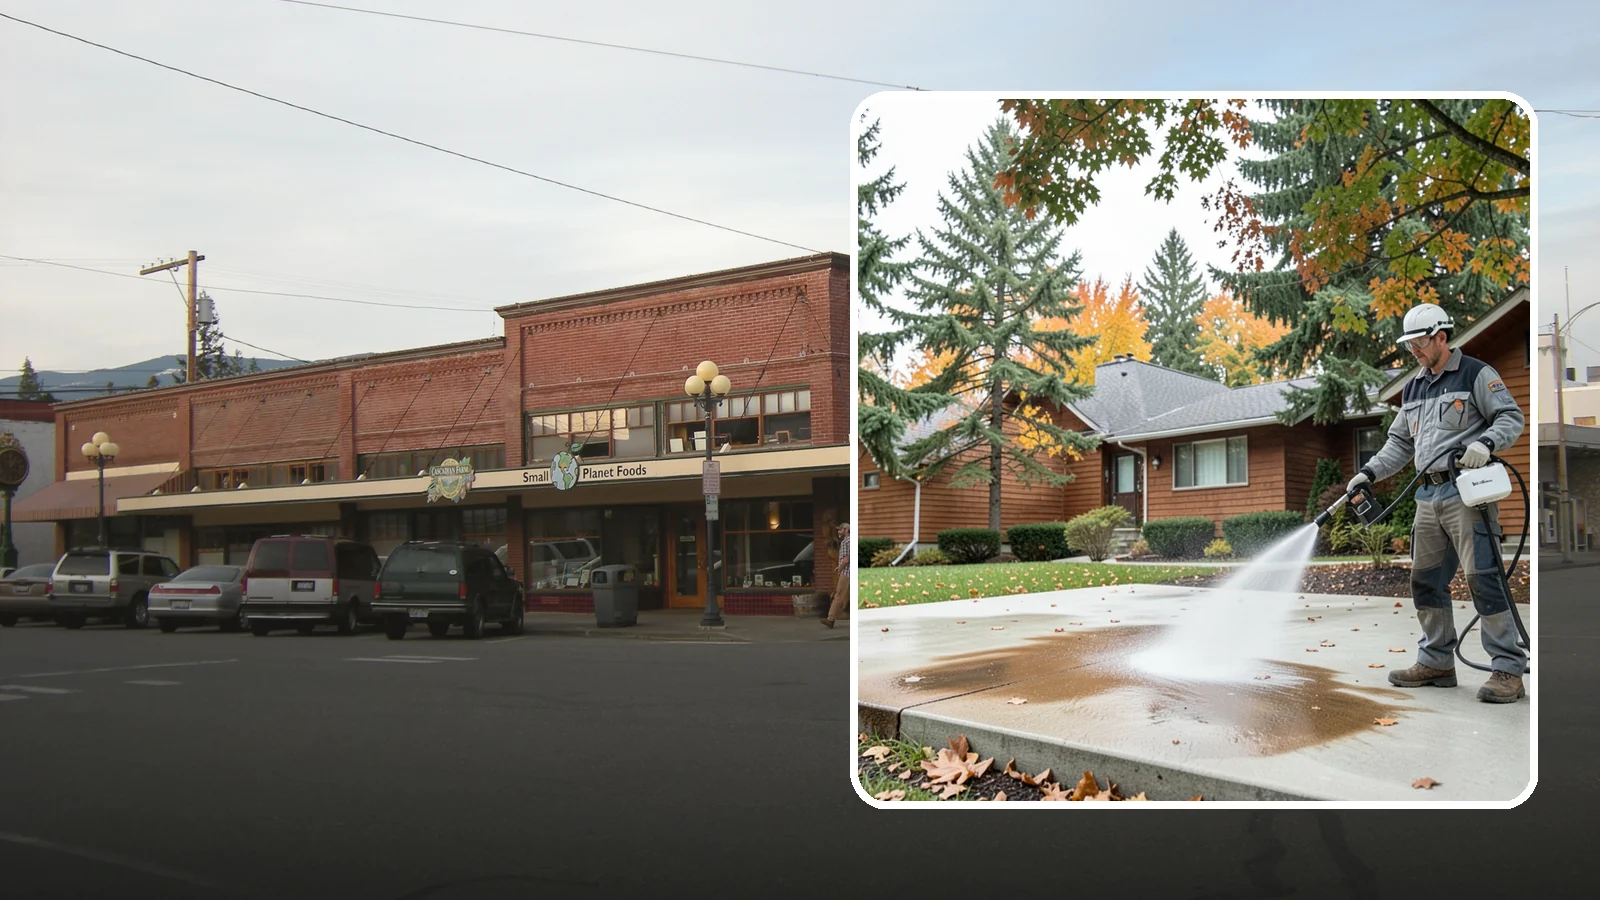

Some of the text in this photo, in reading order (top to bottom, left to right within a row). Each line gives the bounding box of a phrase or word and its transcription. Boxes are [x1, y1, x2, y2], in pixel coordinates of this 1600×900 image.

[523, 464, 647, 483] Small Planet Foods
